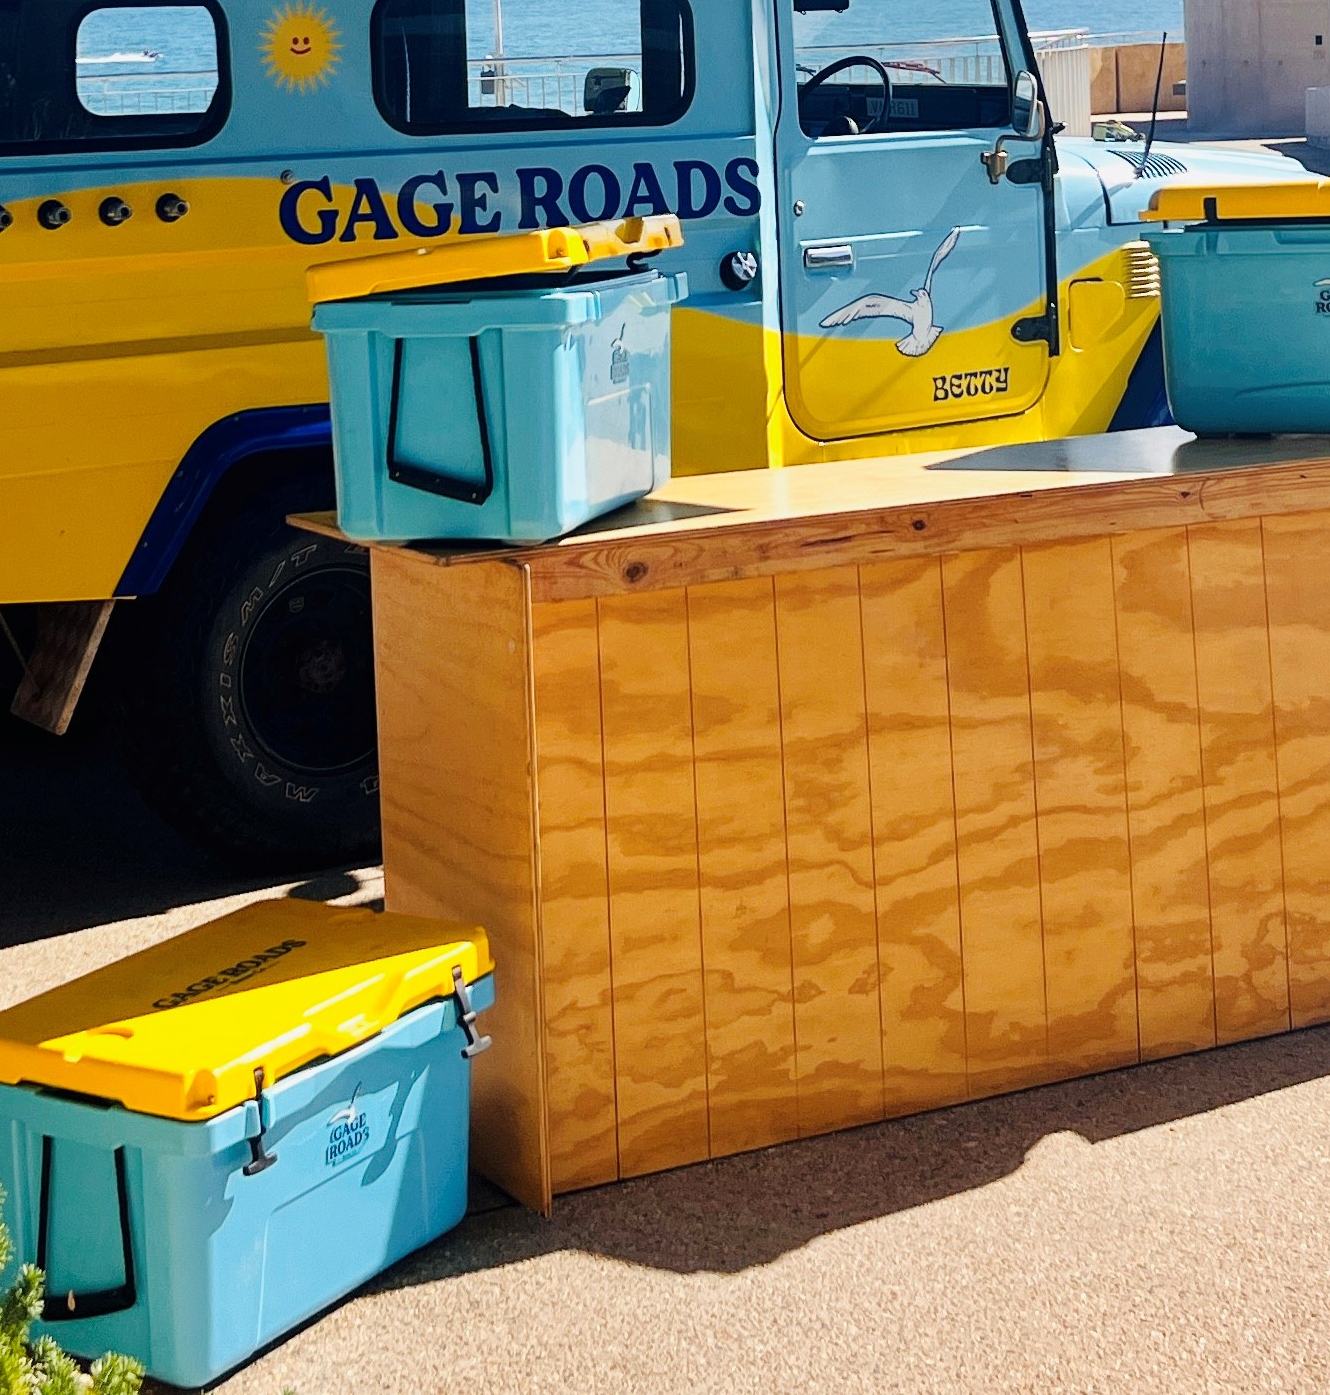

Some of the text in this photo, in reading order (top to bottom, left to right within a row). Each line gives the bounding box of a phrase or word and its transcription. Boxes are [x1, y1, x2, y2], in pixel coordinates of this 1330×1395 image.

[278, 156, 762, 245] GAGE ROADS
[932, 366, 1011, 402] BETTY
[152, 975, 230, 1009] GAGE
[218, 938, 308, 978] ROADS
[331, 1112, 367, 1143] GAGE
